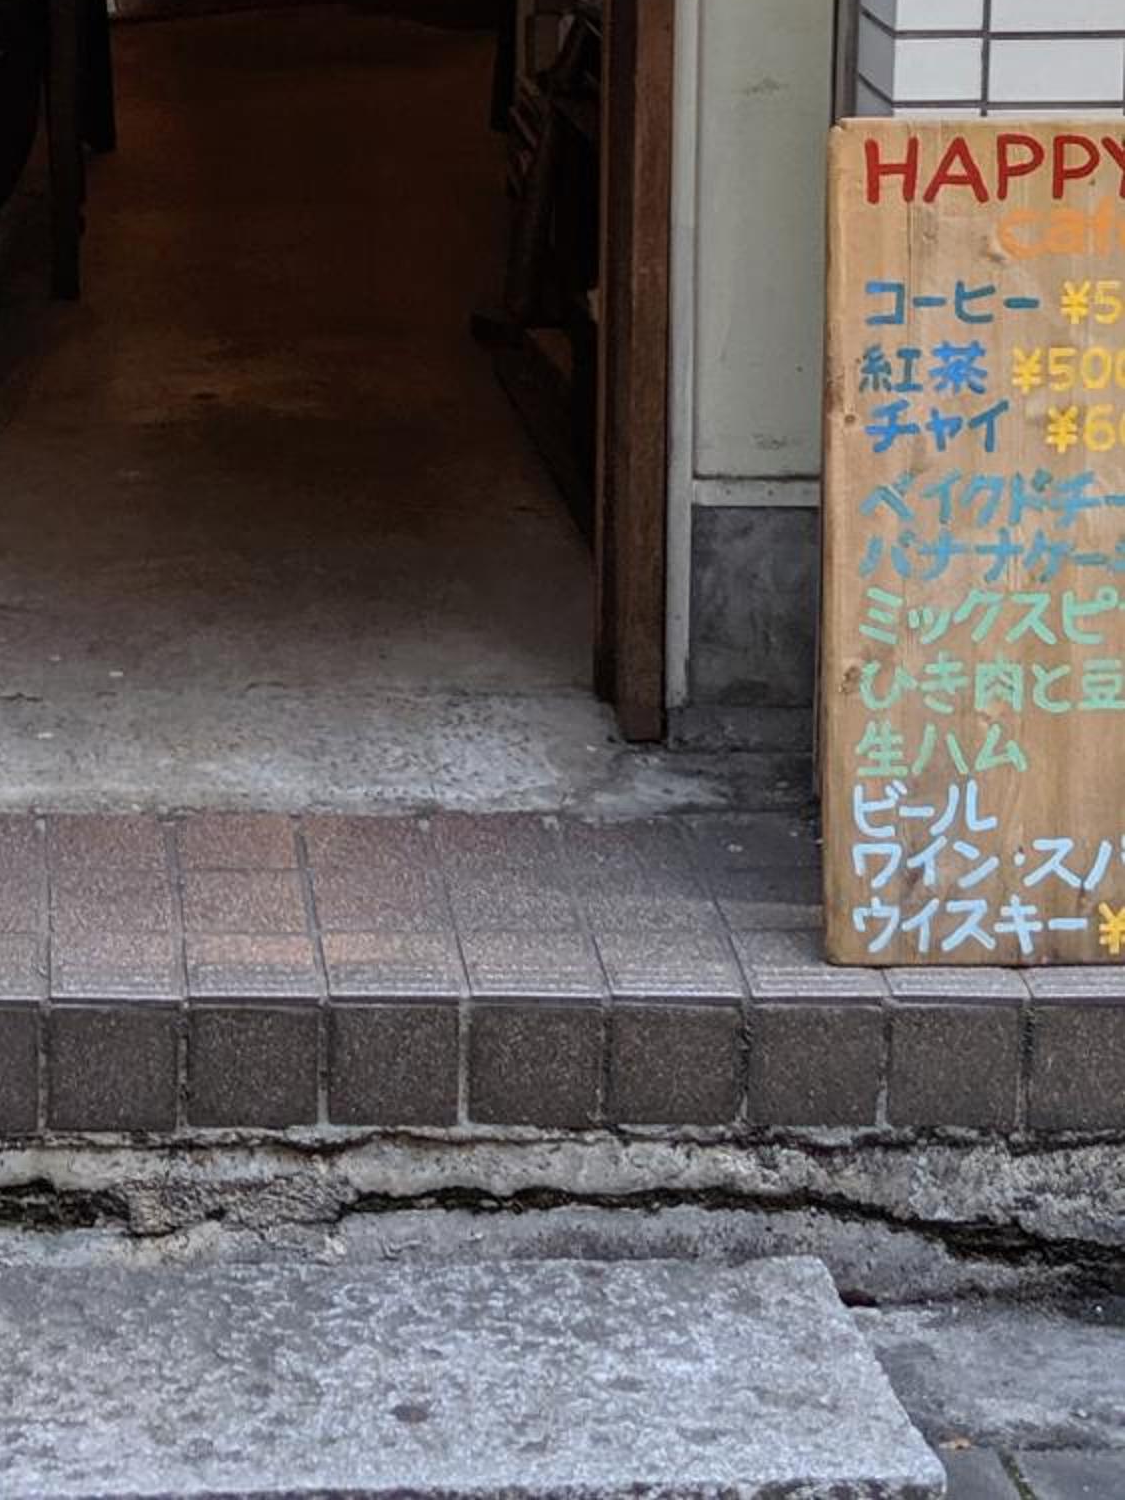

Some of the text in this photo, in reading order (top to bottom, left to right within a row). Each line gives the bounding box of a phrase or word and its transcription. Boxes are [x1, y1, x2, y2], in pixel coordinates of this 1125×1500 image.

[998, 197, 1125, 260] caf
[865, 280, 1040, 325] コーヒー
[858, 340, 988, 395] 紅茶
[864, 399, 1125, 453] チャイ ¥6
[857, 585, 1125, 646] ミックスピ
[857, 651, 1125, 714] ひき肉と豆
[855, 719, 1029, 778] 生ハム
[851, 779, 999, 838] ビール
[851, 894, 1089, 954] ウイスキー
